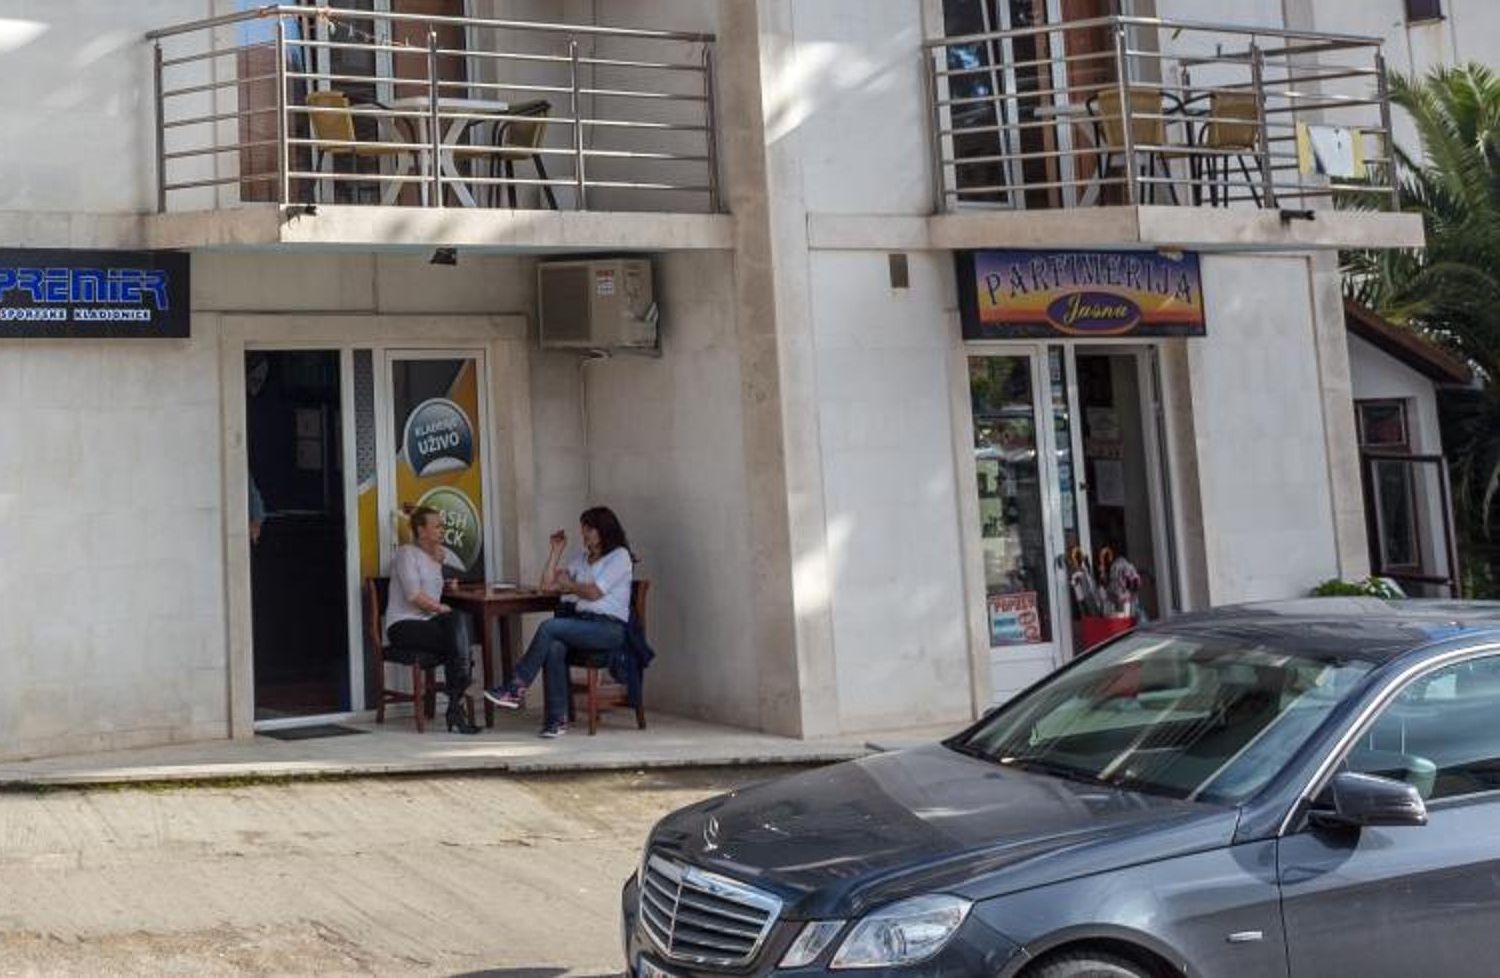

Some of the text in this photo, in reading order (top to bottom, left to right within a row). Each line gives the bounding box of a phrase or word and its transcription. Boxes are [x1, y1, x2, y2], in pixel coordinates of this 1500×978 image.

[0, 308, 152, 321] SPORTSKE KLADIONICE
[1062, 293, 1129, 325] Jasna
[417, 430, 461, 456] UŽIVO
[438, 508, 468, 529] ASH
[443, 528, 465, 548] CK
